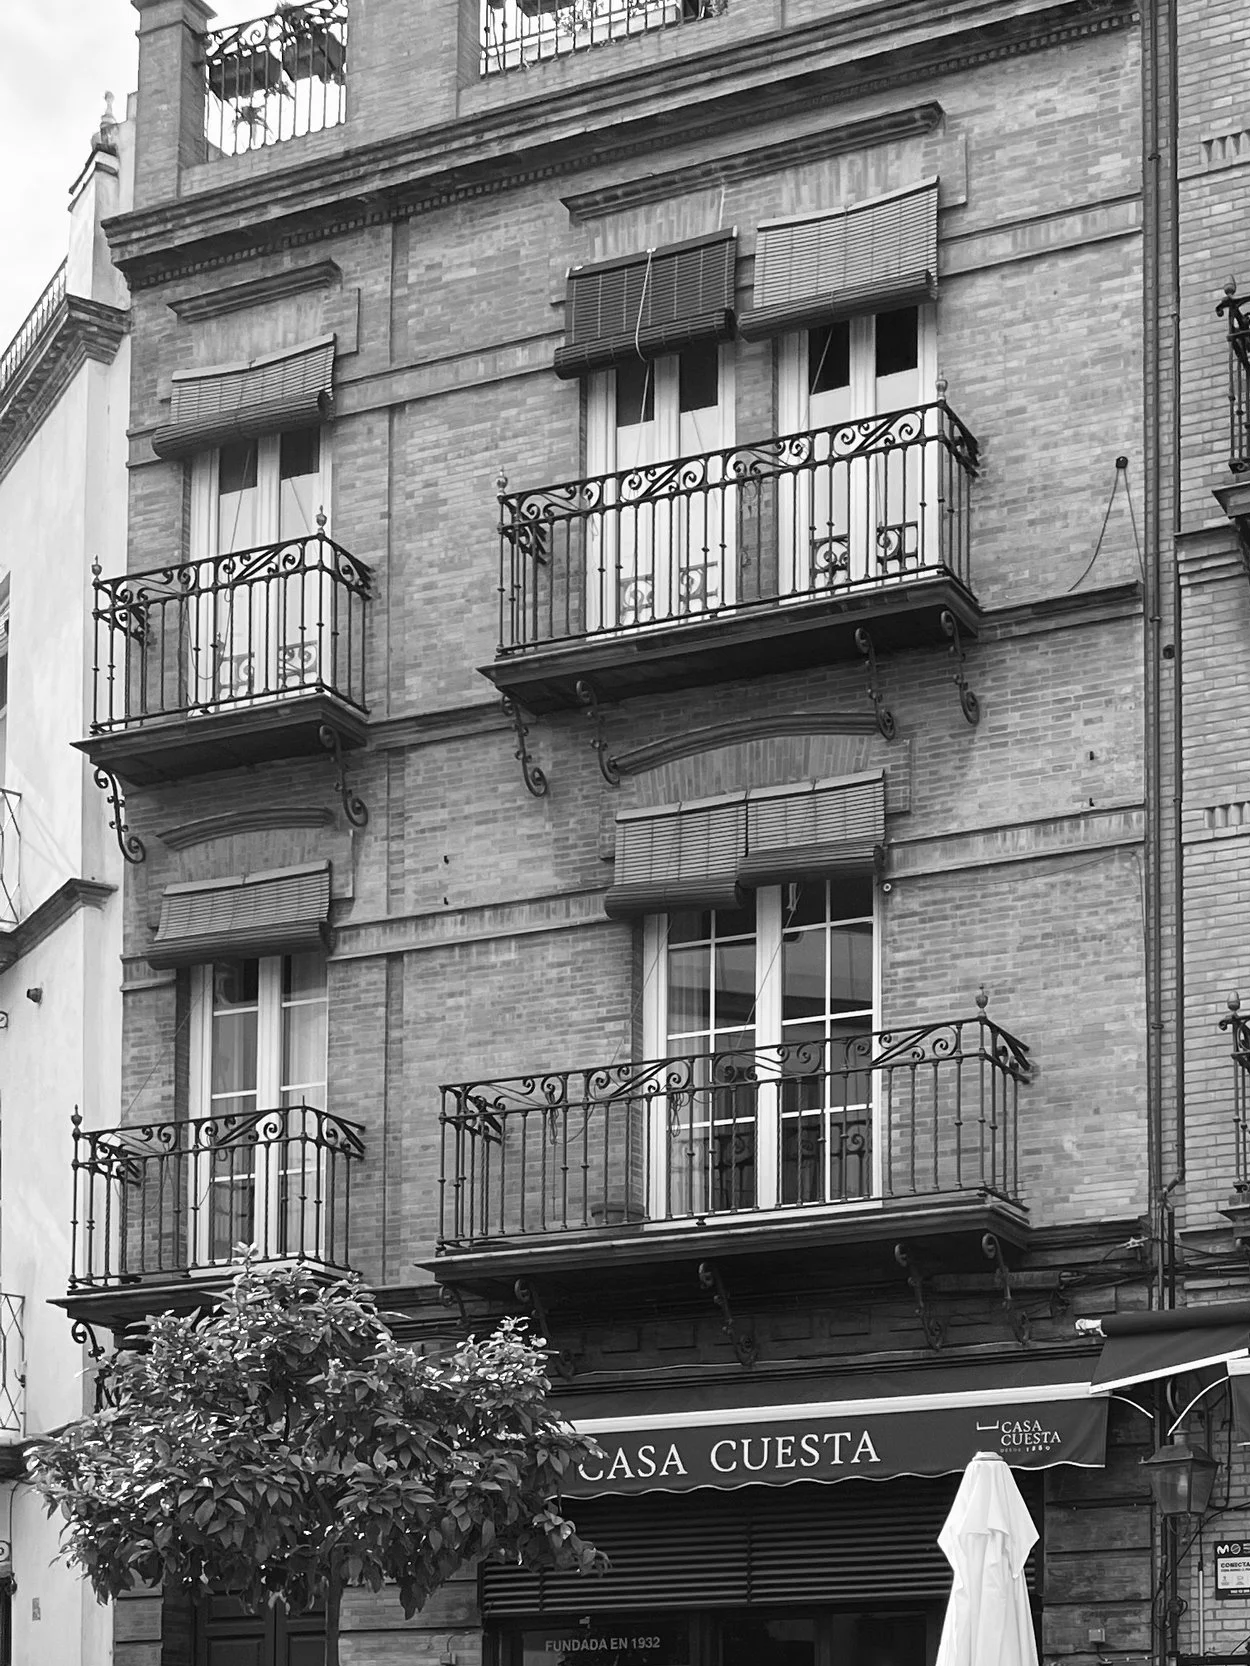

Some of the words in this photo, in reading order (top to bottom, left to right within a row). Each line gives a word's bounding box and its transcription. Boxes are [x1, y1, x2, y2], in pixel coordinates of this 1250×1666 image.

[1001, 1419, 1043, 1434] CASA
[1000, 1431, 1062, 1446] CUESTA
[578, 1444, 688, 1481] CASA
[710, 1430, 881, 1473] CUESTA
[545, 1638, 608, 1653] FUNDADA
[610, 1637, 628, 1650] EN
[631, 1636, 661, 1650] 1932
